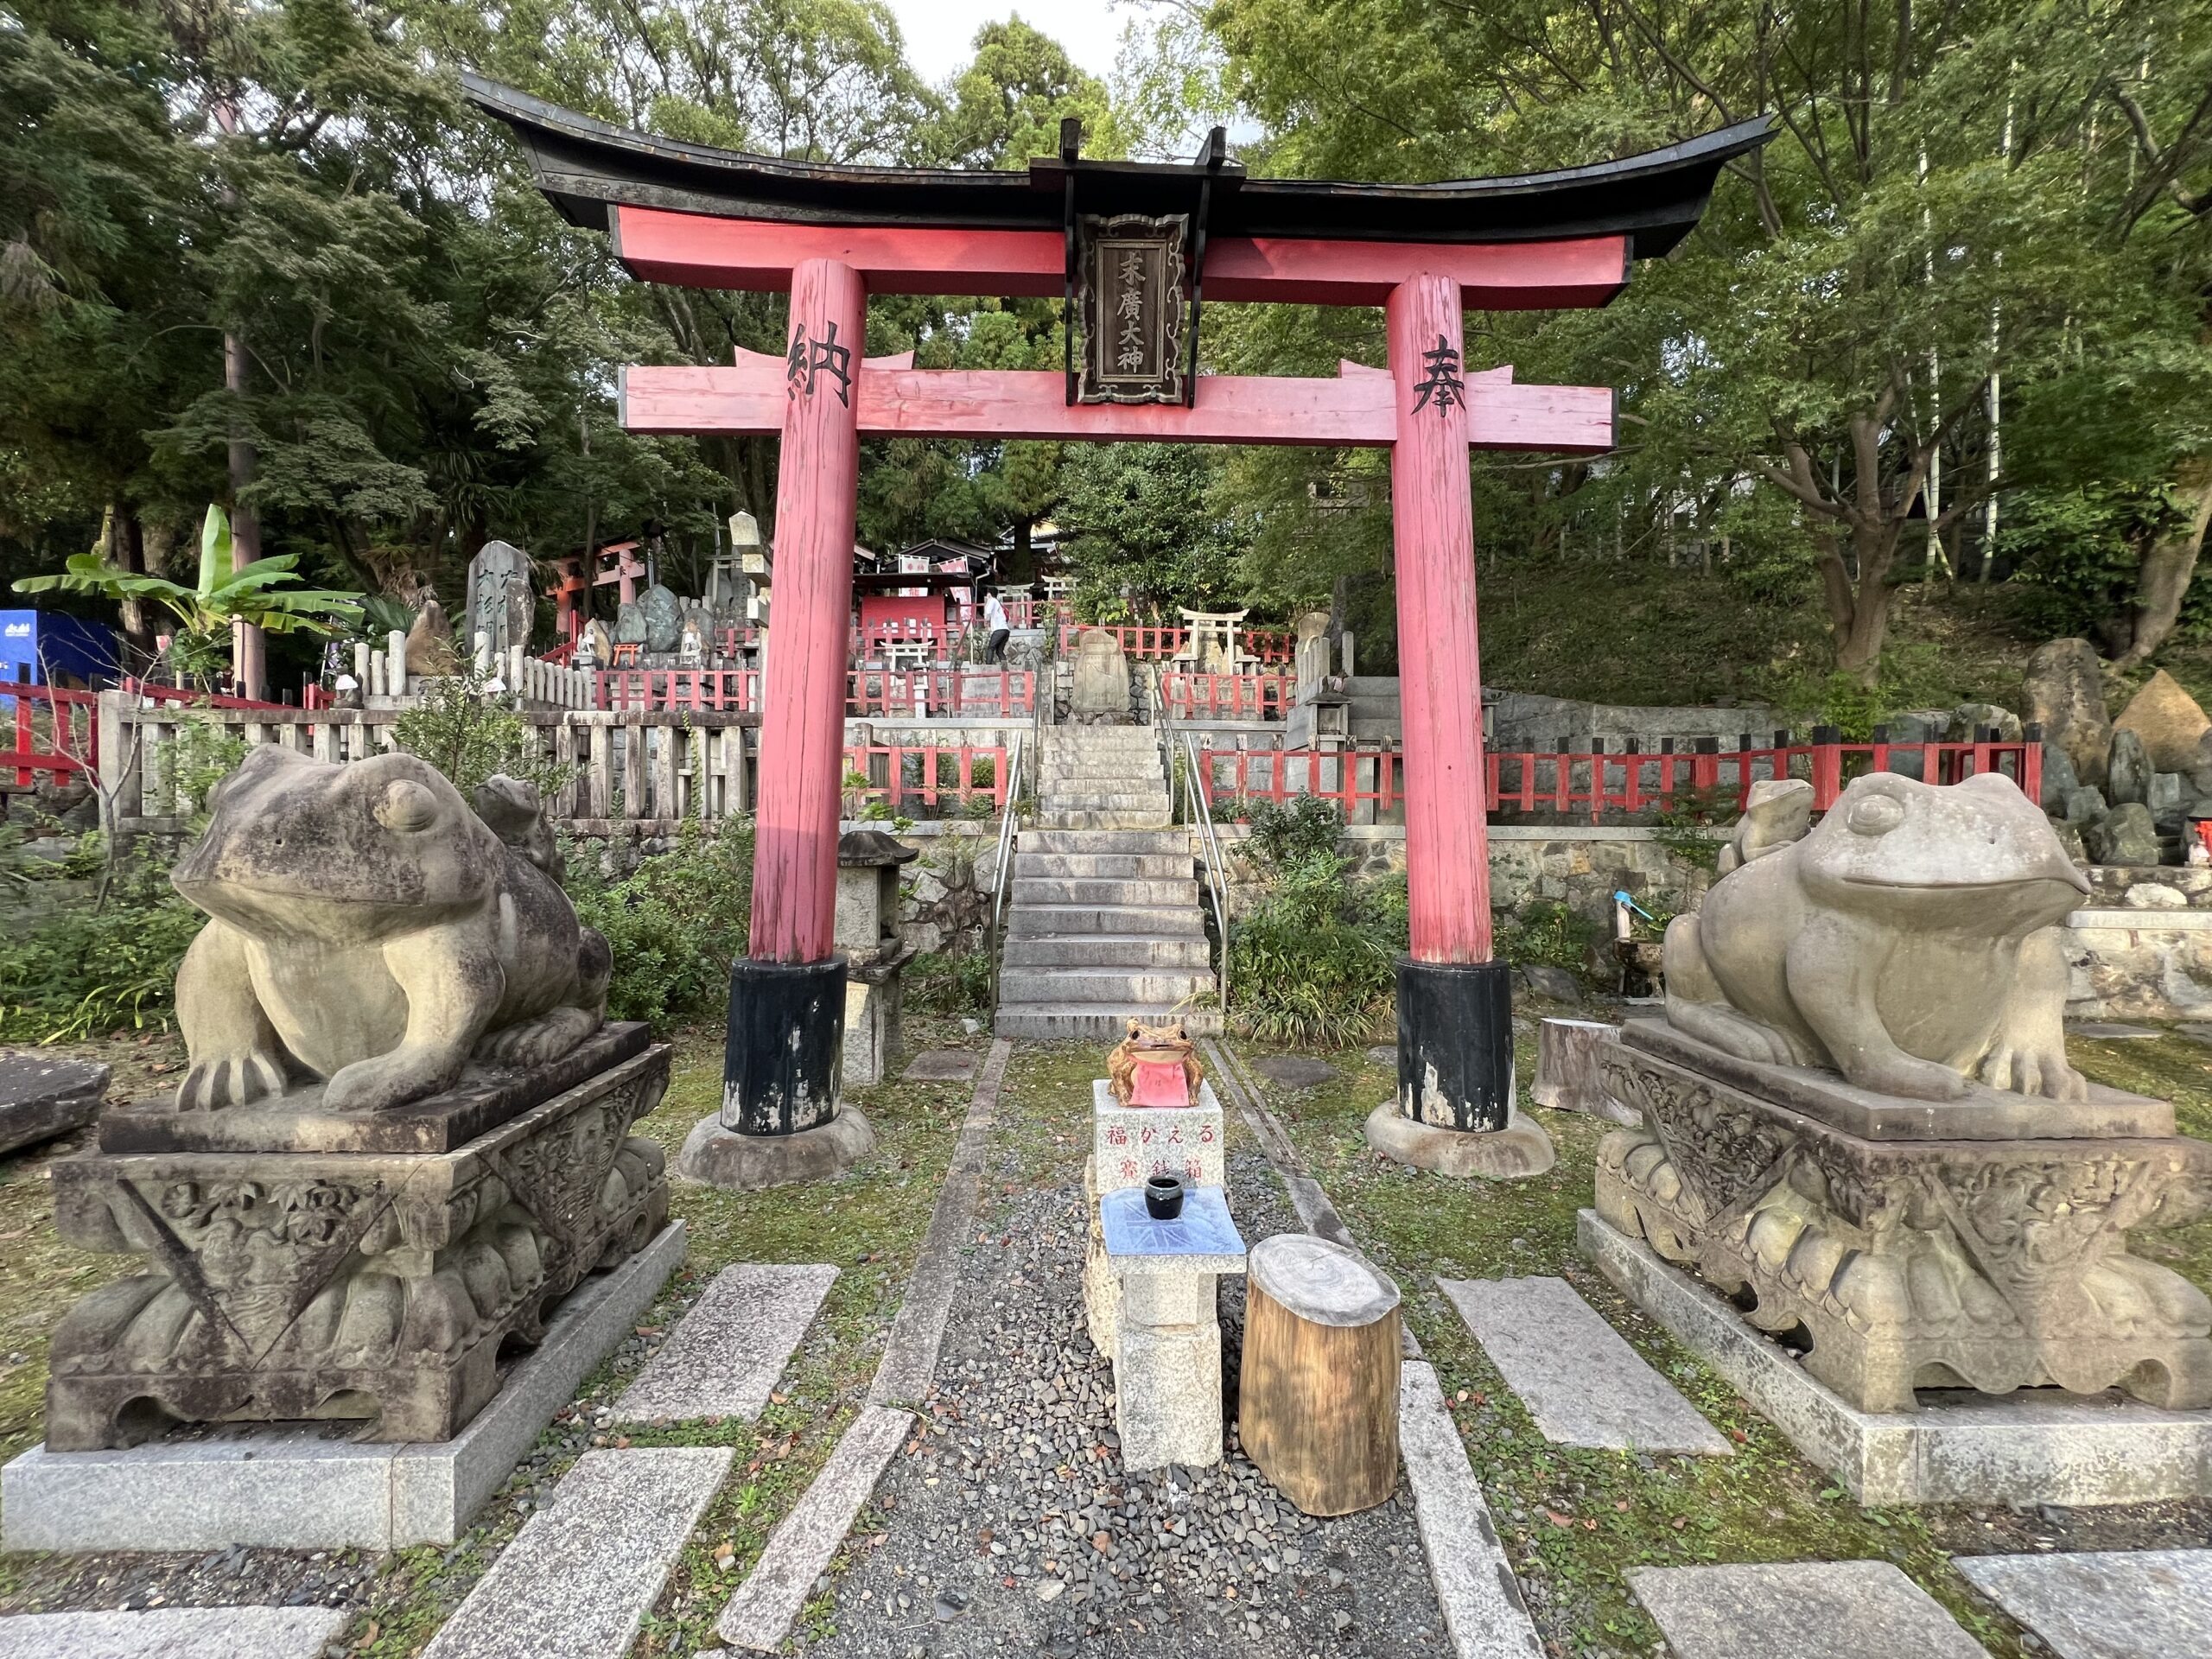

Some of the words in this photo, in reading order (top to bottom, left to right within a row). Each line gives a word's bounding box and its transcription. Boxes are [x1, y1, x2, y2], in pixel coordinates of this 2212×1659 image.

[1117, 251, 1146, 374] 末廣大神
[787, 320, 852, 410] 納
[1410, 334, 1467, 418] 奉
[1106, 1124, 1215, 1146] 福かえる
[1119, 1158, 1203, 1179] 賽銭箱
